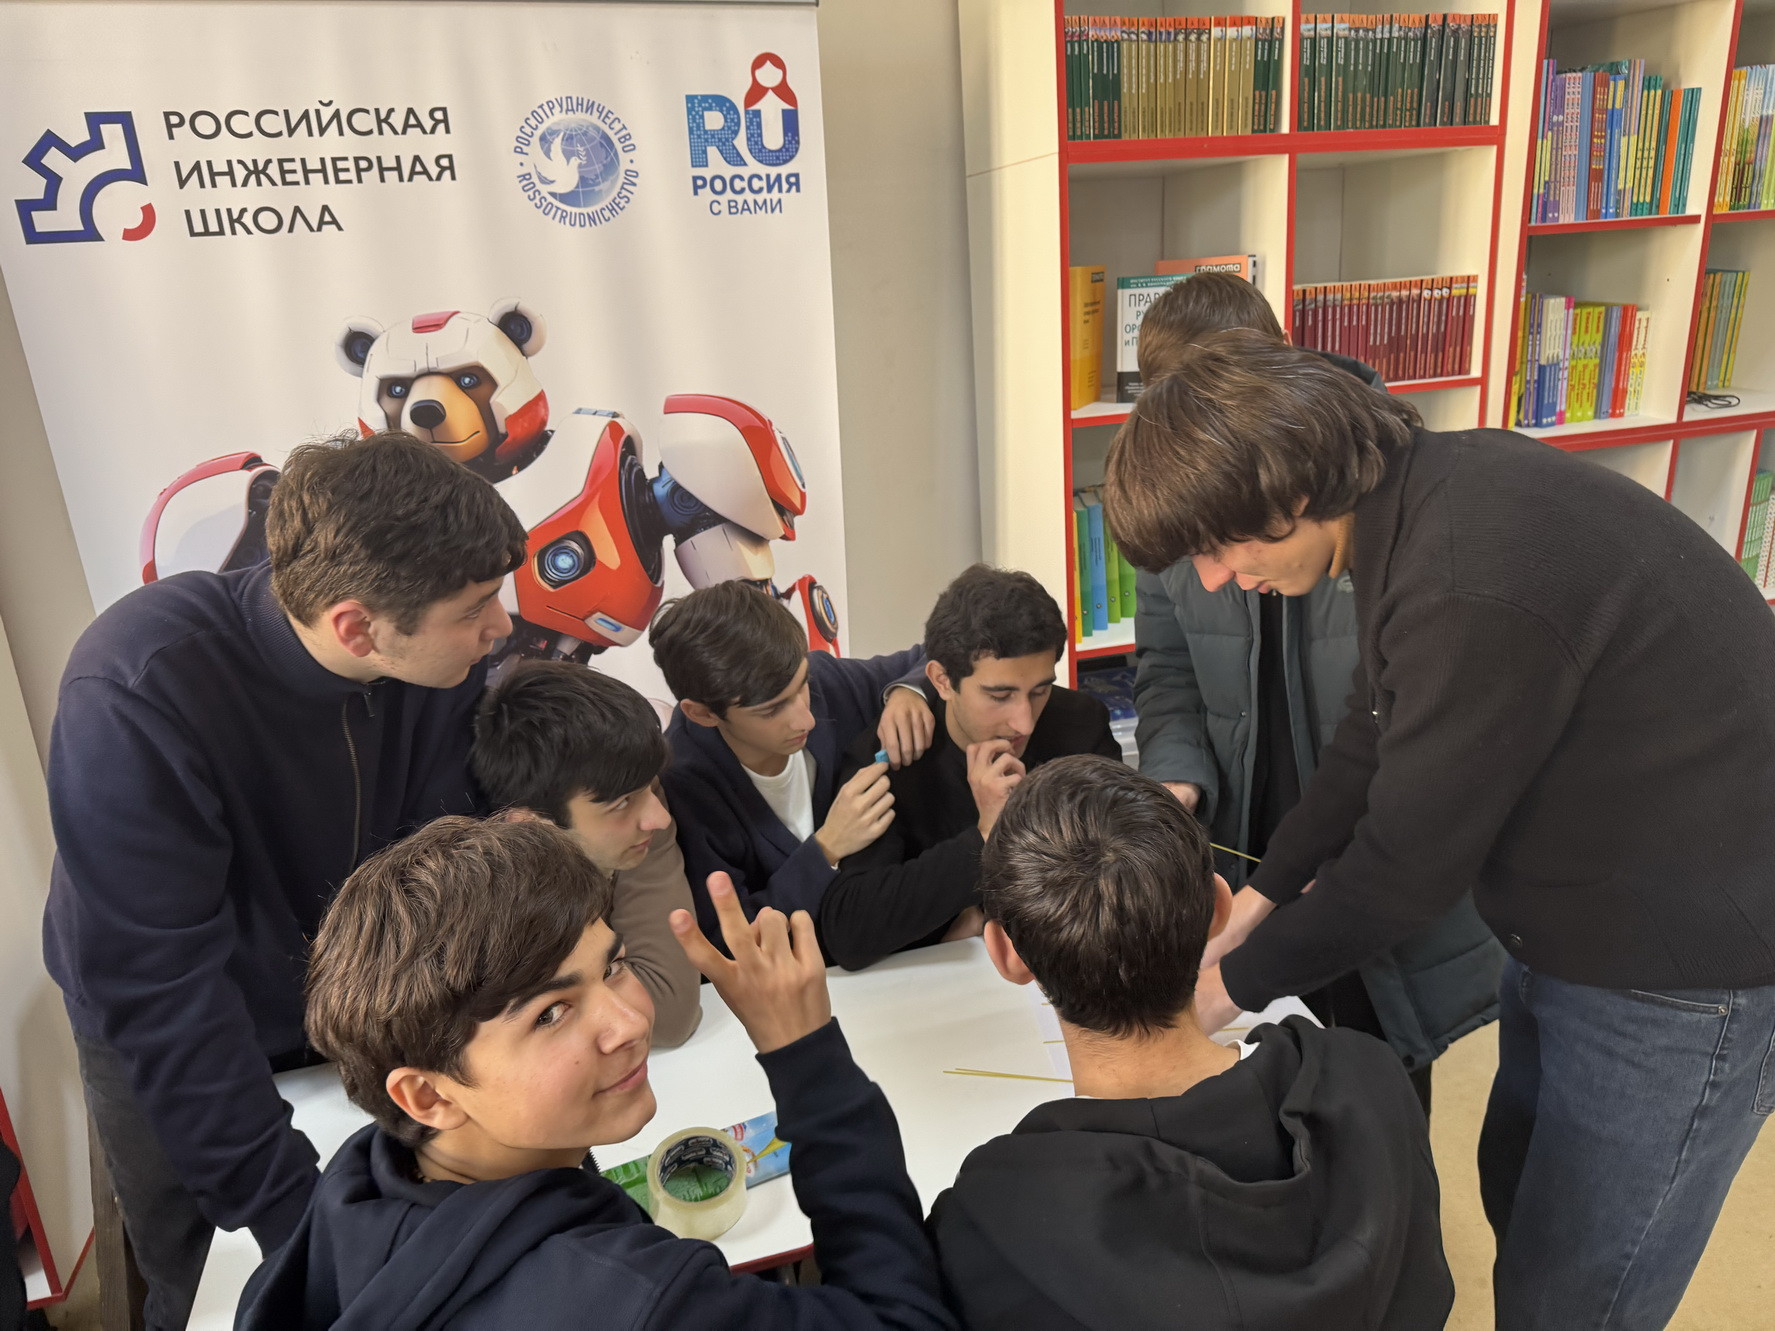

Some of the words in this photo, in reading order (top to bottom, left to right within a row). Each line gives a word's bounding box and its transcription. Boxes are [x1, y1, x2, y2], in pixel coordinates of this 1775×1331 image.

[163, 100, 451, 140] РОССИЙСКАЯ
[514, 96, 636, 156] РОССОТРУДНИЧЕСТВО
[685, 93, 800, 168] RU
[174, 154, 456, 190] ИНЖЕНЕРНАЯ
[692, 172, 801, 196] РОССИЯ
[517, 169, 639, 228] ROSSOTRUDNICHESTVO
[709, 200, 722, 216] С
[728, 198, 783, 216] ВАМИ
[184, 205, 344, 237] ШКОЛА
